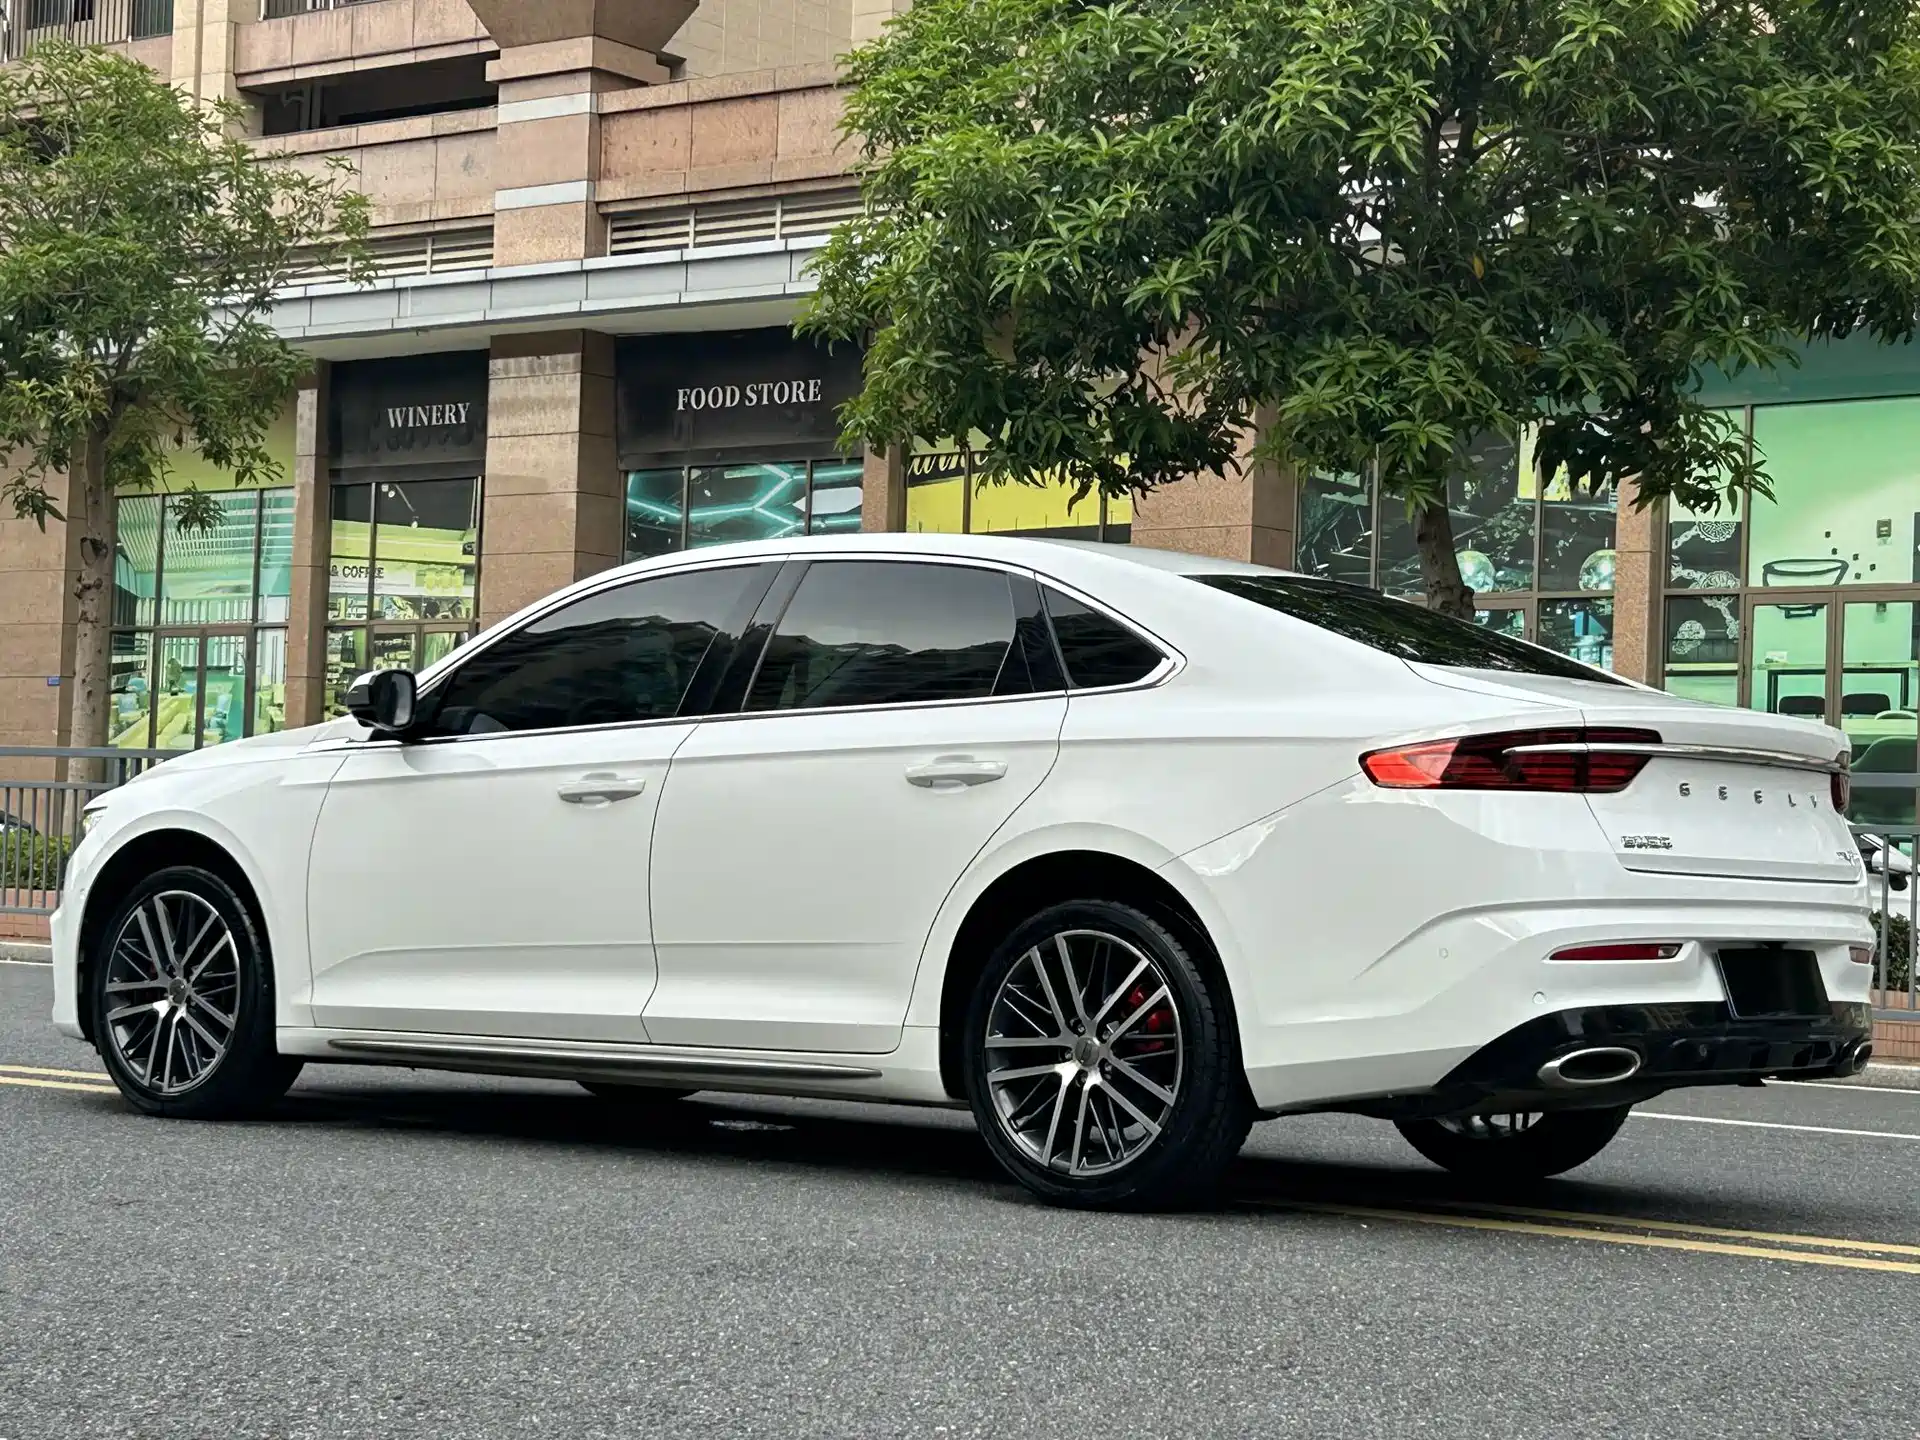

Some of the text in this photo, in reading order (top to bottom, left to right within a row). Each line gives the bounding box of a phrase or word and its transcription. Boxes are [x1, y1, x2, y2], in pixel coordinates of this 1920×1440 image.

[676, 378, 821, 411] FOOD STORE
[387, 402, 471, 428] WINERY
[342, 565, 384, 579] COFFE
